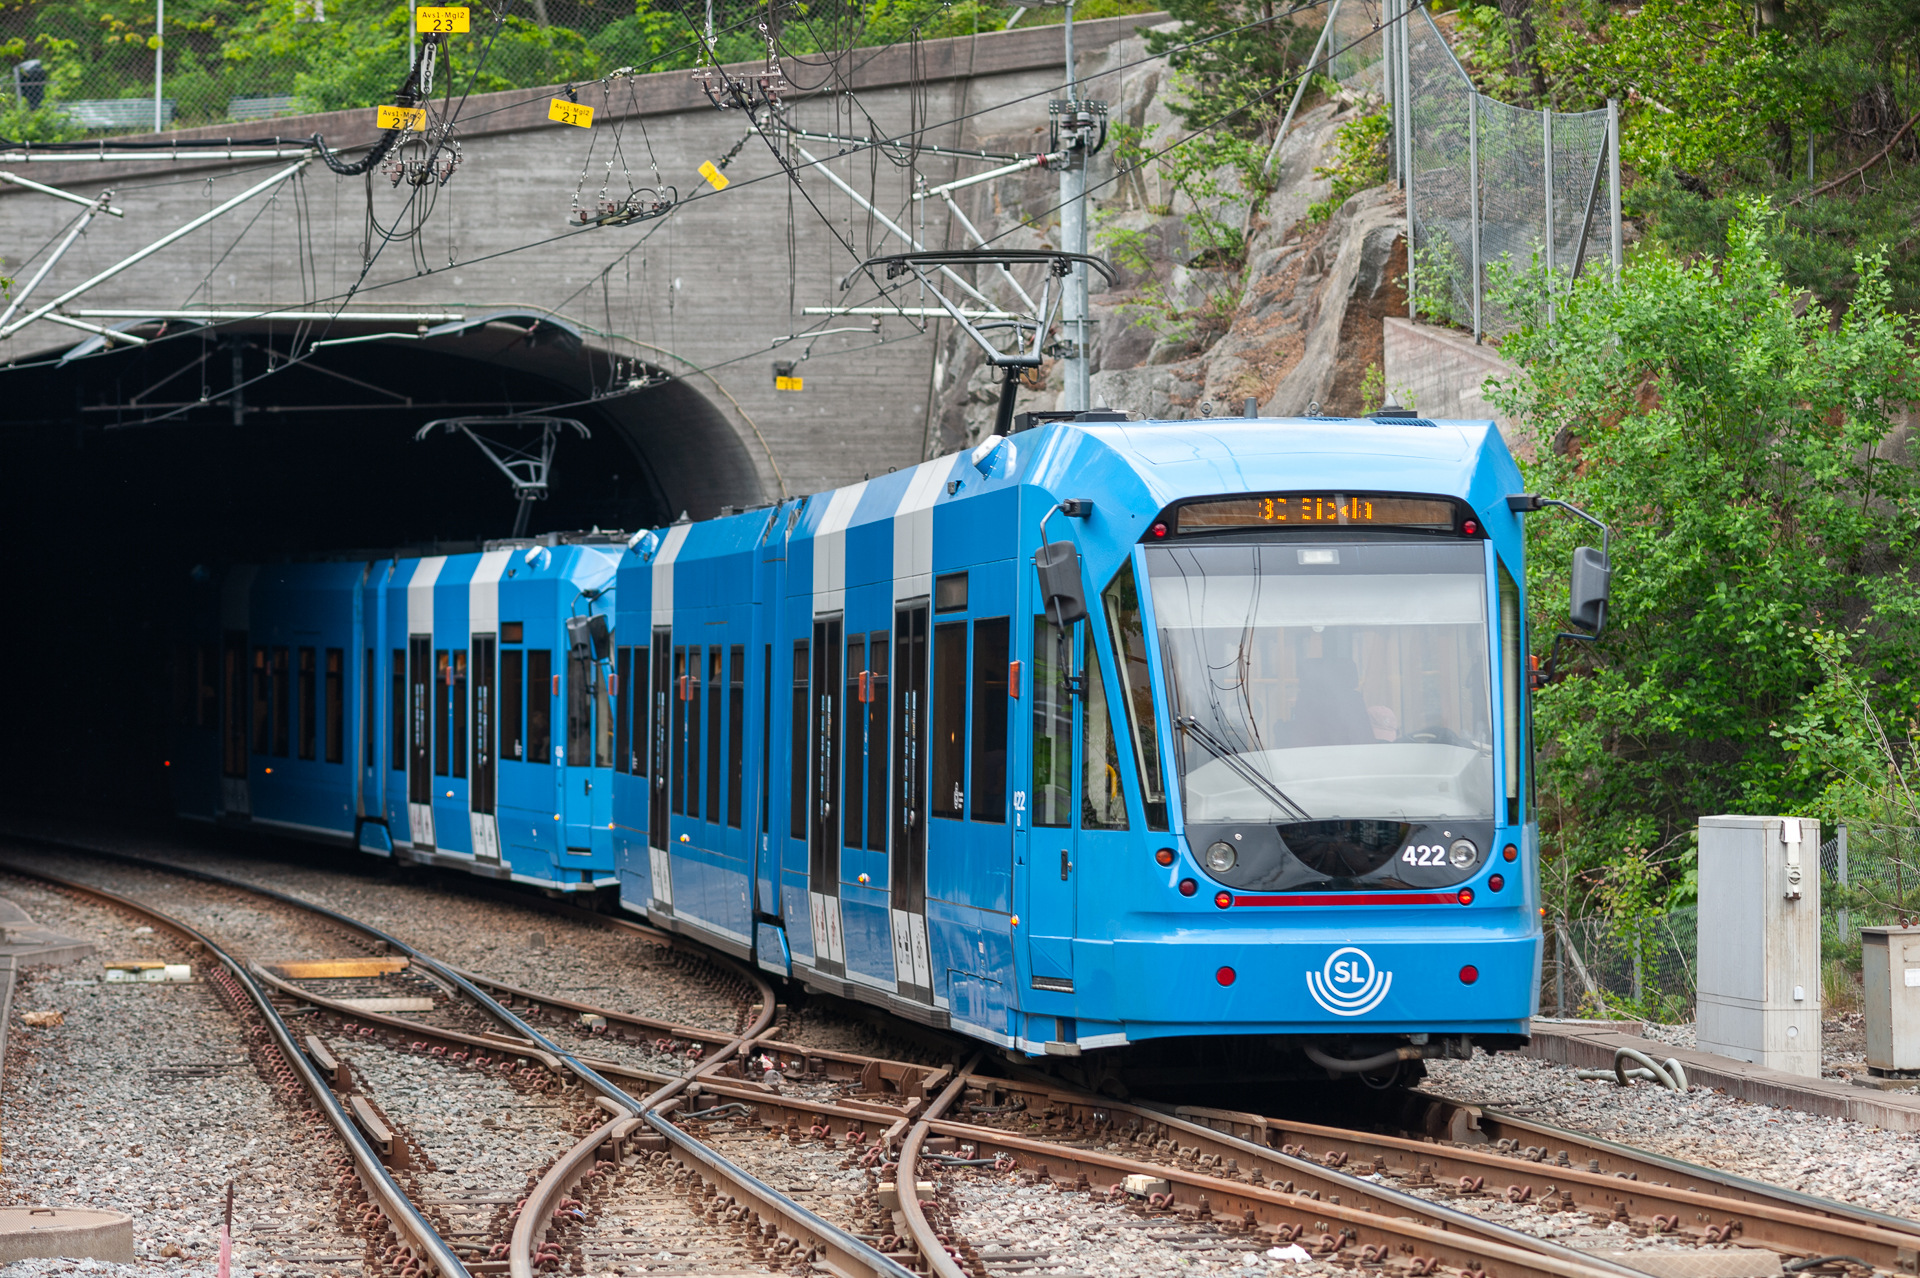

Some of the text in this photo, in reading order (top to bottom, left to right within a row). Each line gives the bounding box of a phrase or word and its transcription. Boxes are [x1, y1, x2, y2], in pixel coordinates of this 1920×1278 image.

[433, 19, 453, 31] 23
[562, 111, 578, 125] 21
[1402, 845, 1446, 866] 422
[1334, 961, 1365, 983] SL
